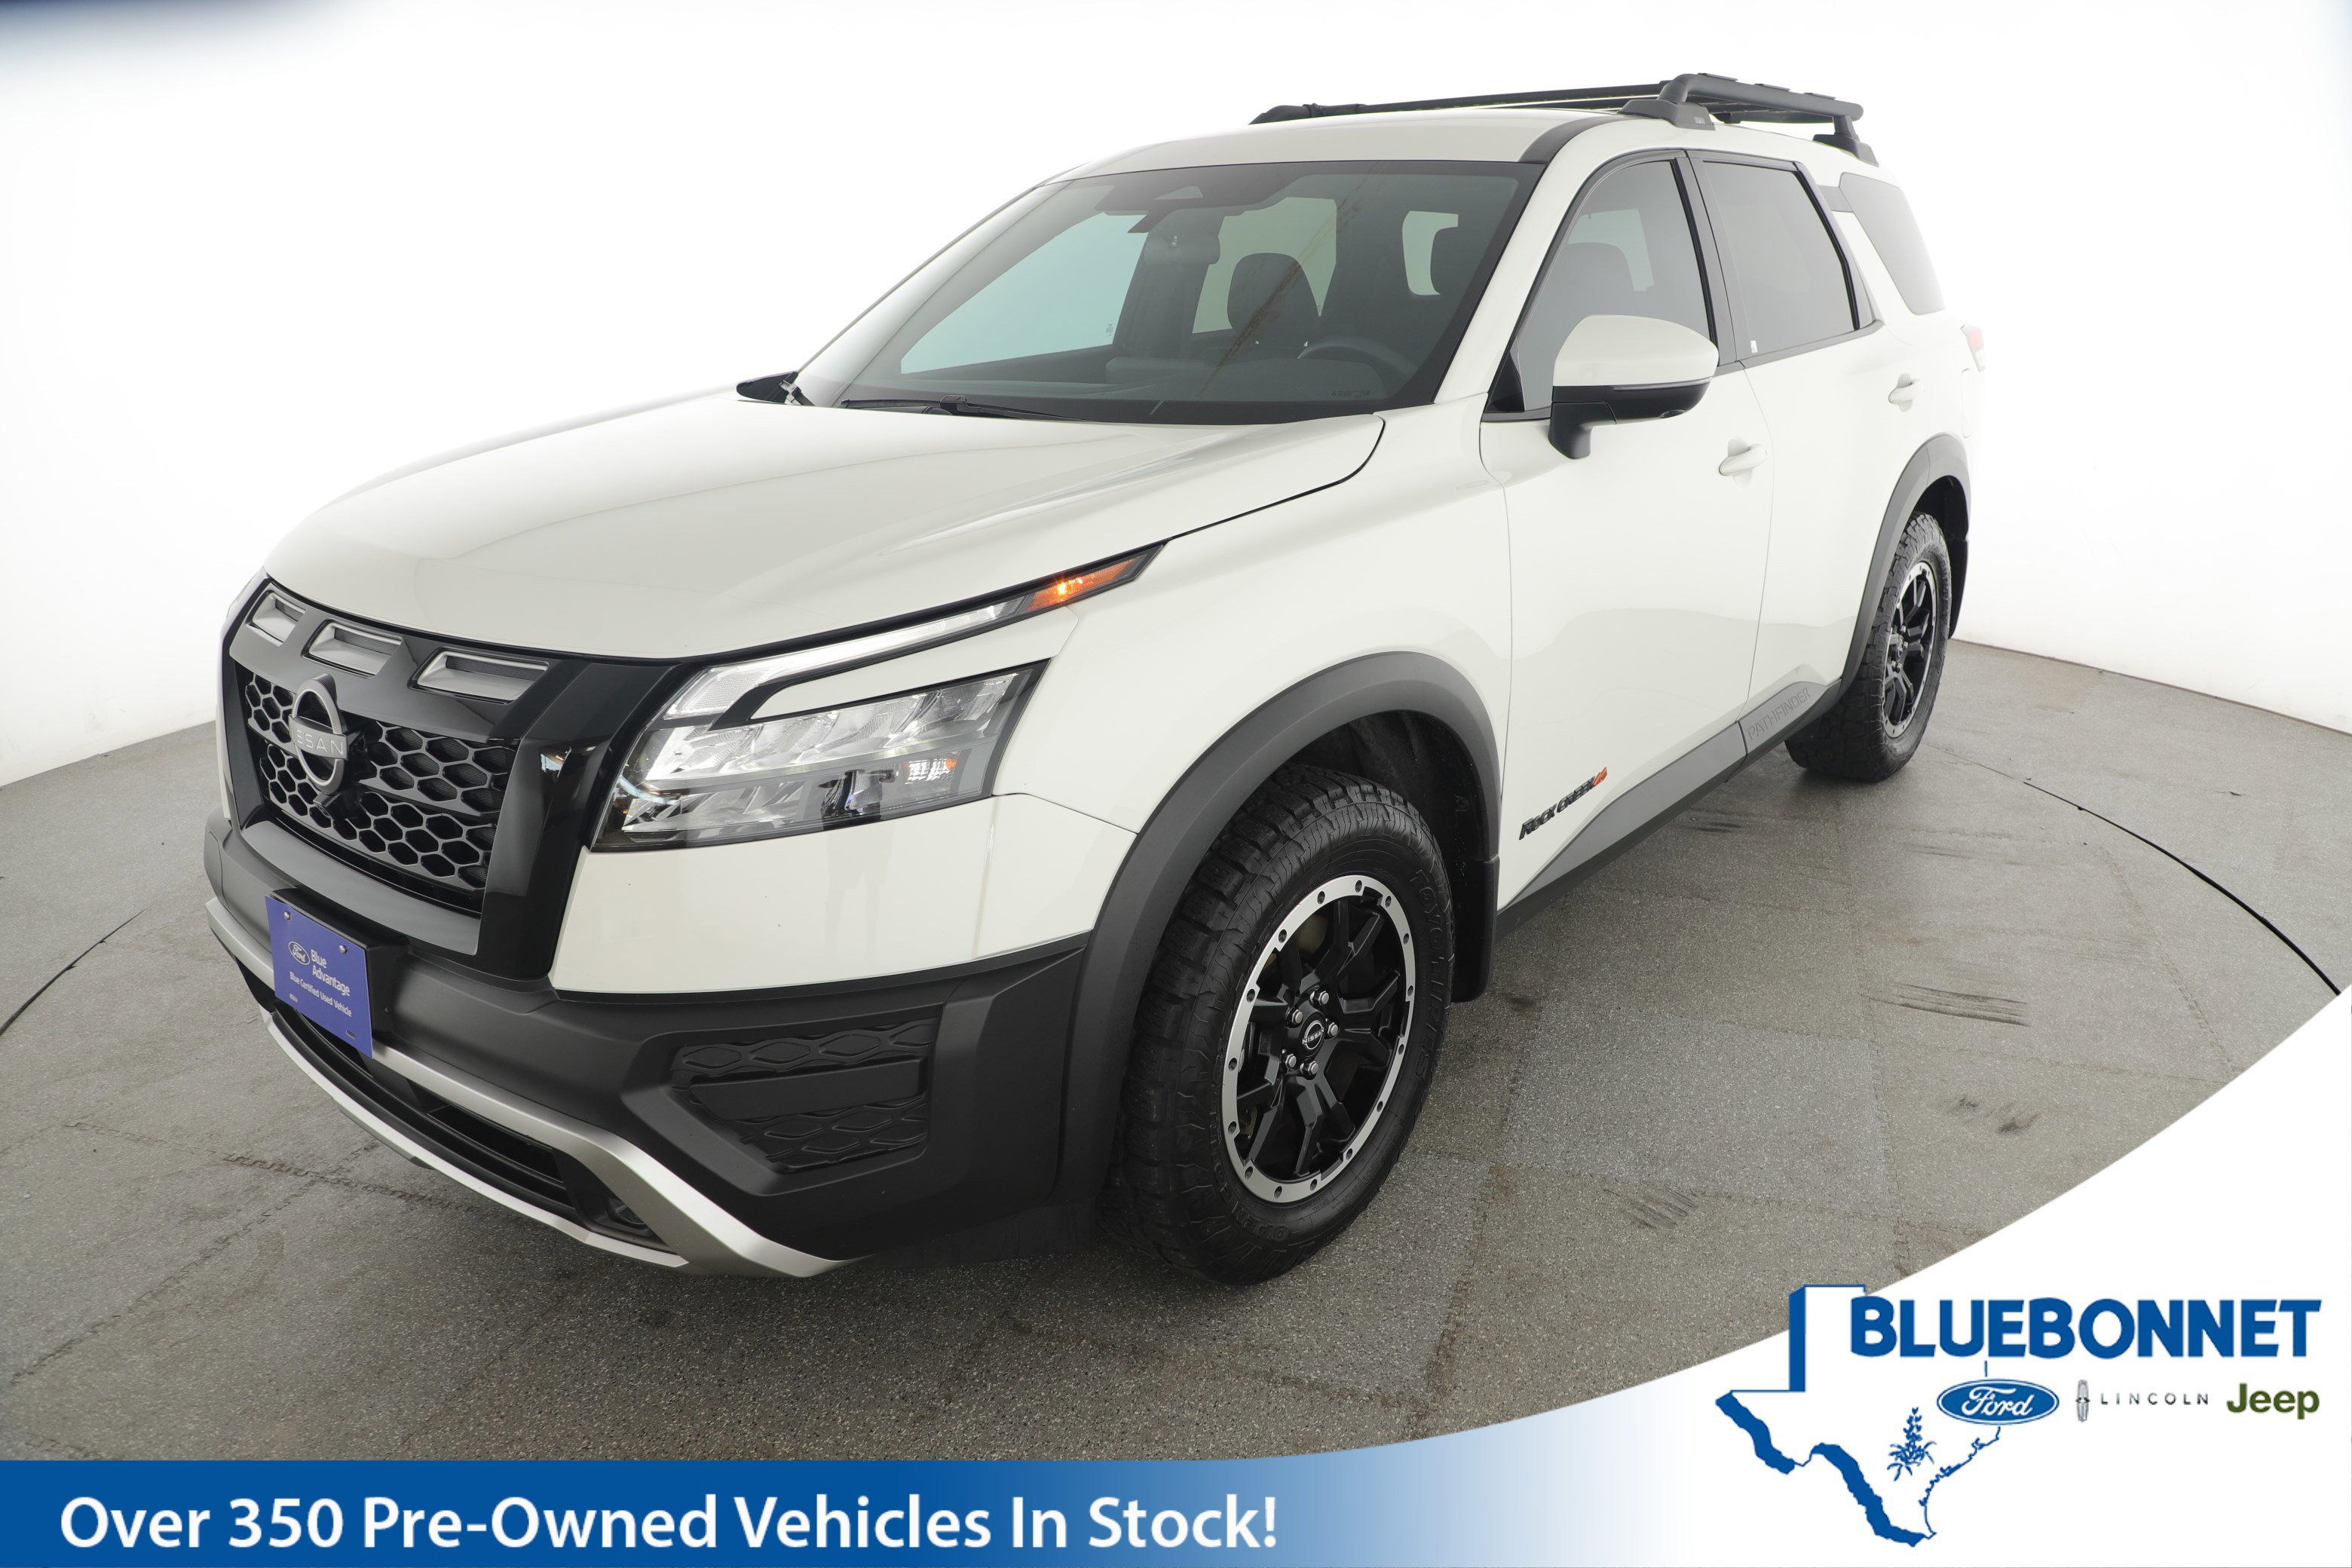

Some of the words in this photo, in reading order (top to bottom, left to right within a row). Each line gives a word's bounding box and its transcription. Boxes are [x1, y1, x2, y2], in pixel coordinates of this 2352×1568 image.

[1745, 687, 1811, 741] PATHFINDER
[296, 729, 345, 755] SSAN
[1409, 868, 1445, 950] TOYO
[311, 949, 327, 969] Blue
[289, 971, 300, 985] Blue
[300, 978, 320, 997] Certified
[320, 991, 333, 1006] Used
[333, 1000, 352, 1017] Vehicle
[312, 964, 351, 997] Advantage
[1302, 1026, 1325, 1045] NISSAN
